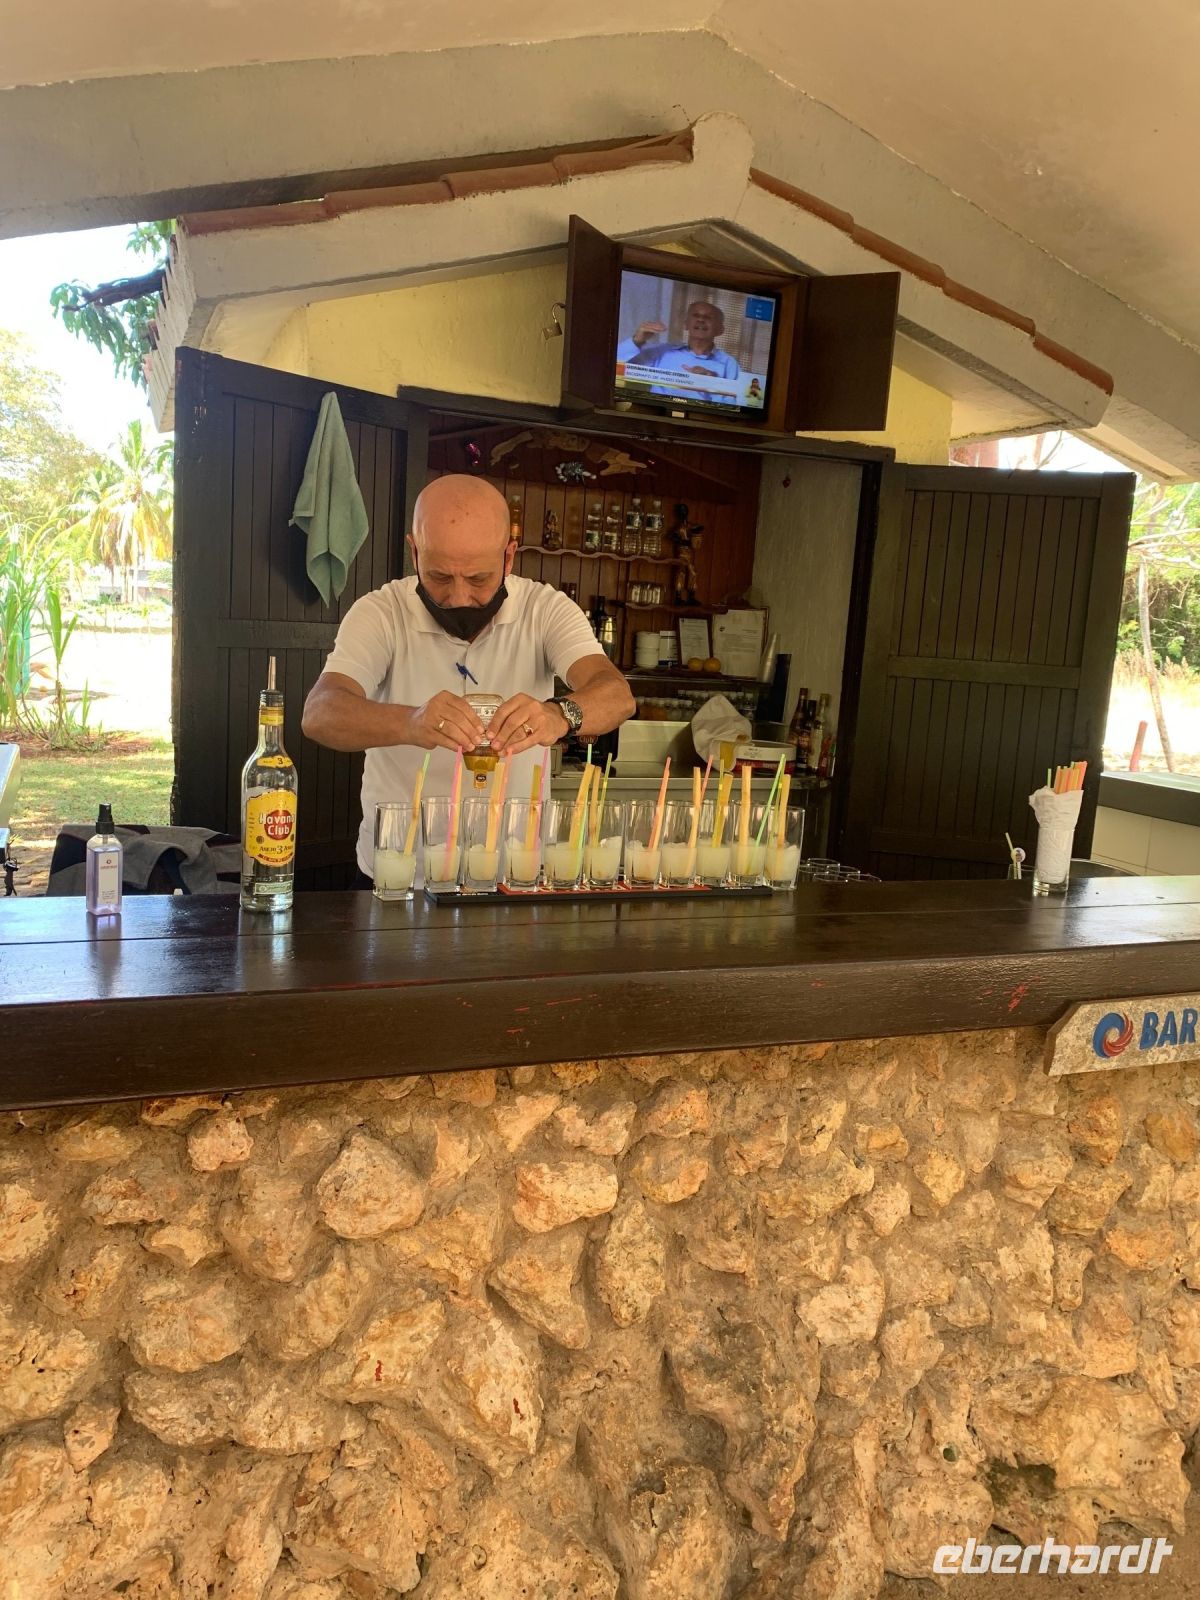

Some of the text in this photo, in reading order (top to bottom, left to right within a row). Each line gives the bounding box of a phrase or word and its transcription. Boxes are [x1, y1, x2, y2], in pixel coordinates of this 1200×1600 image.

[277, 757, 284, 765] 3
[259, 814, 295, 825] Havana
[268, 825, 290, 836] Club
[276, 845, 283, 854] 3
[1139, 1008, 1198, 1050] BAR
